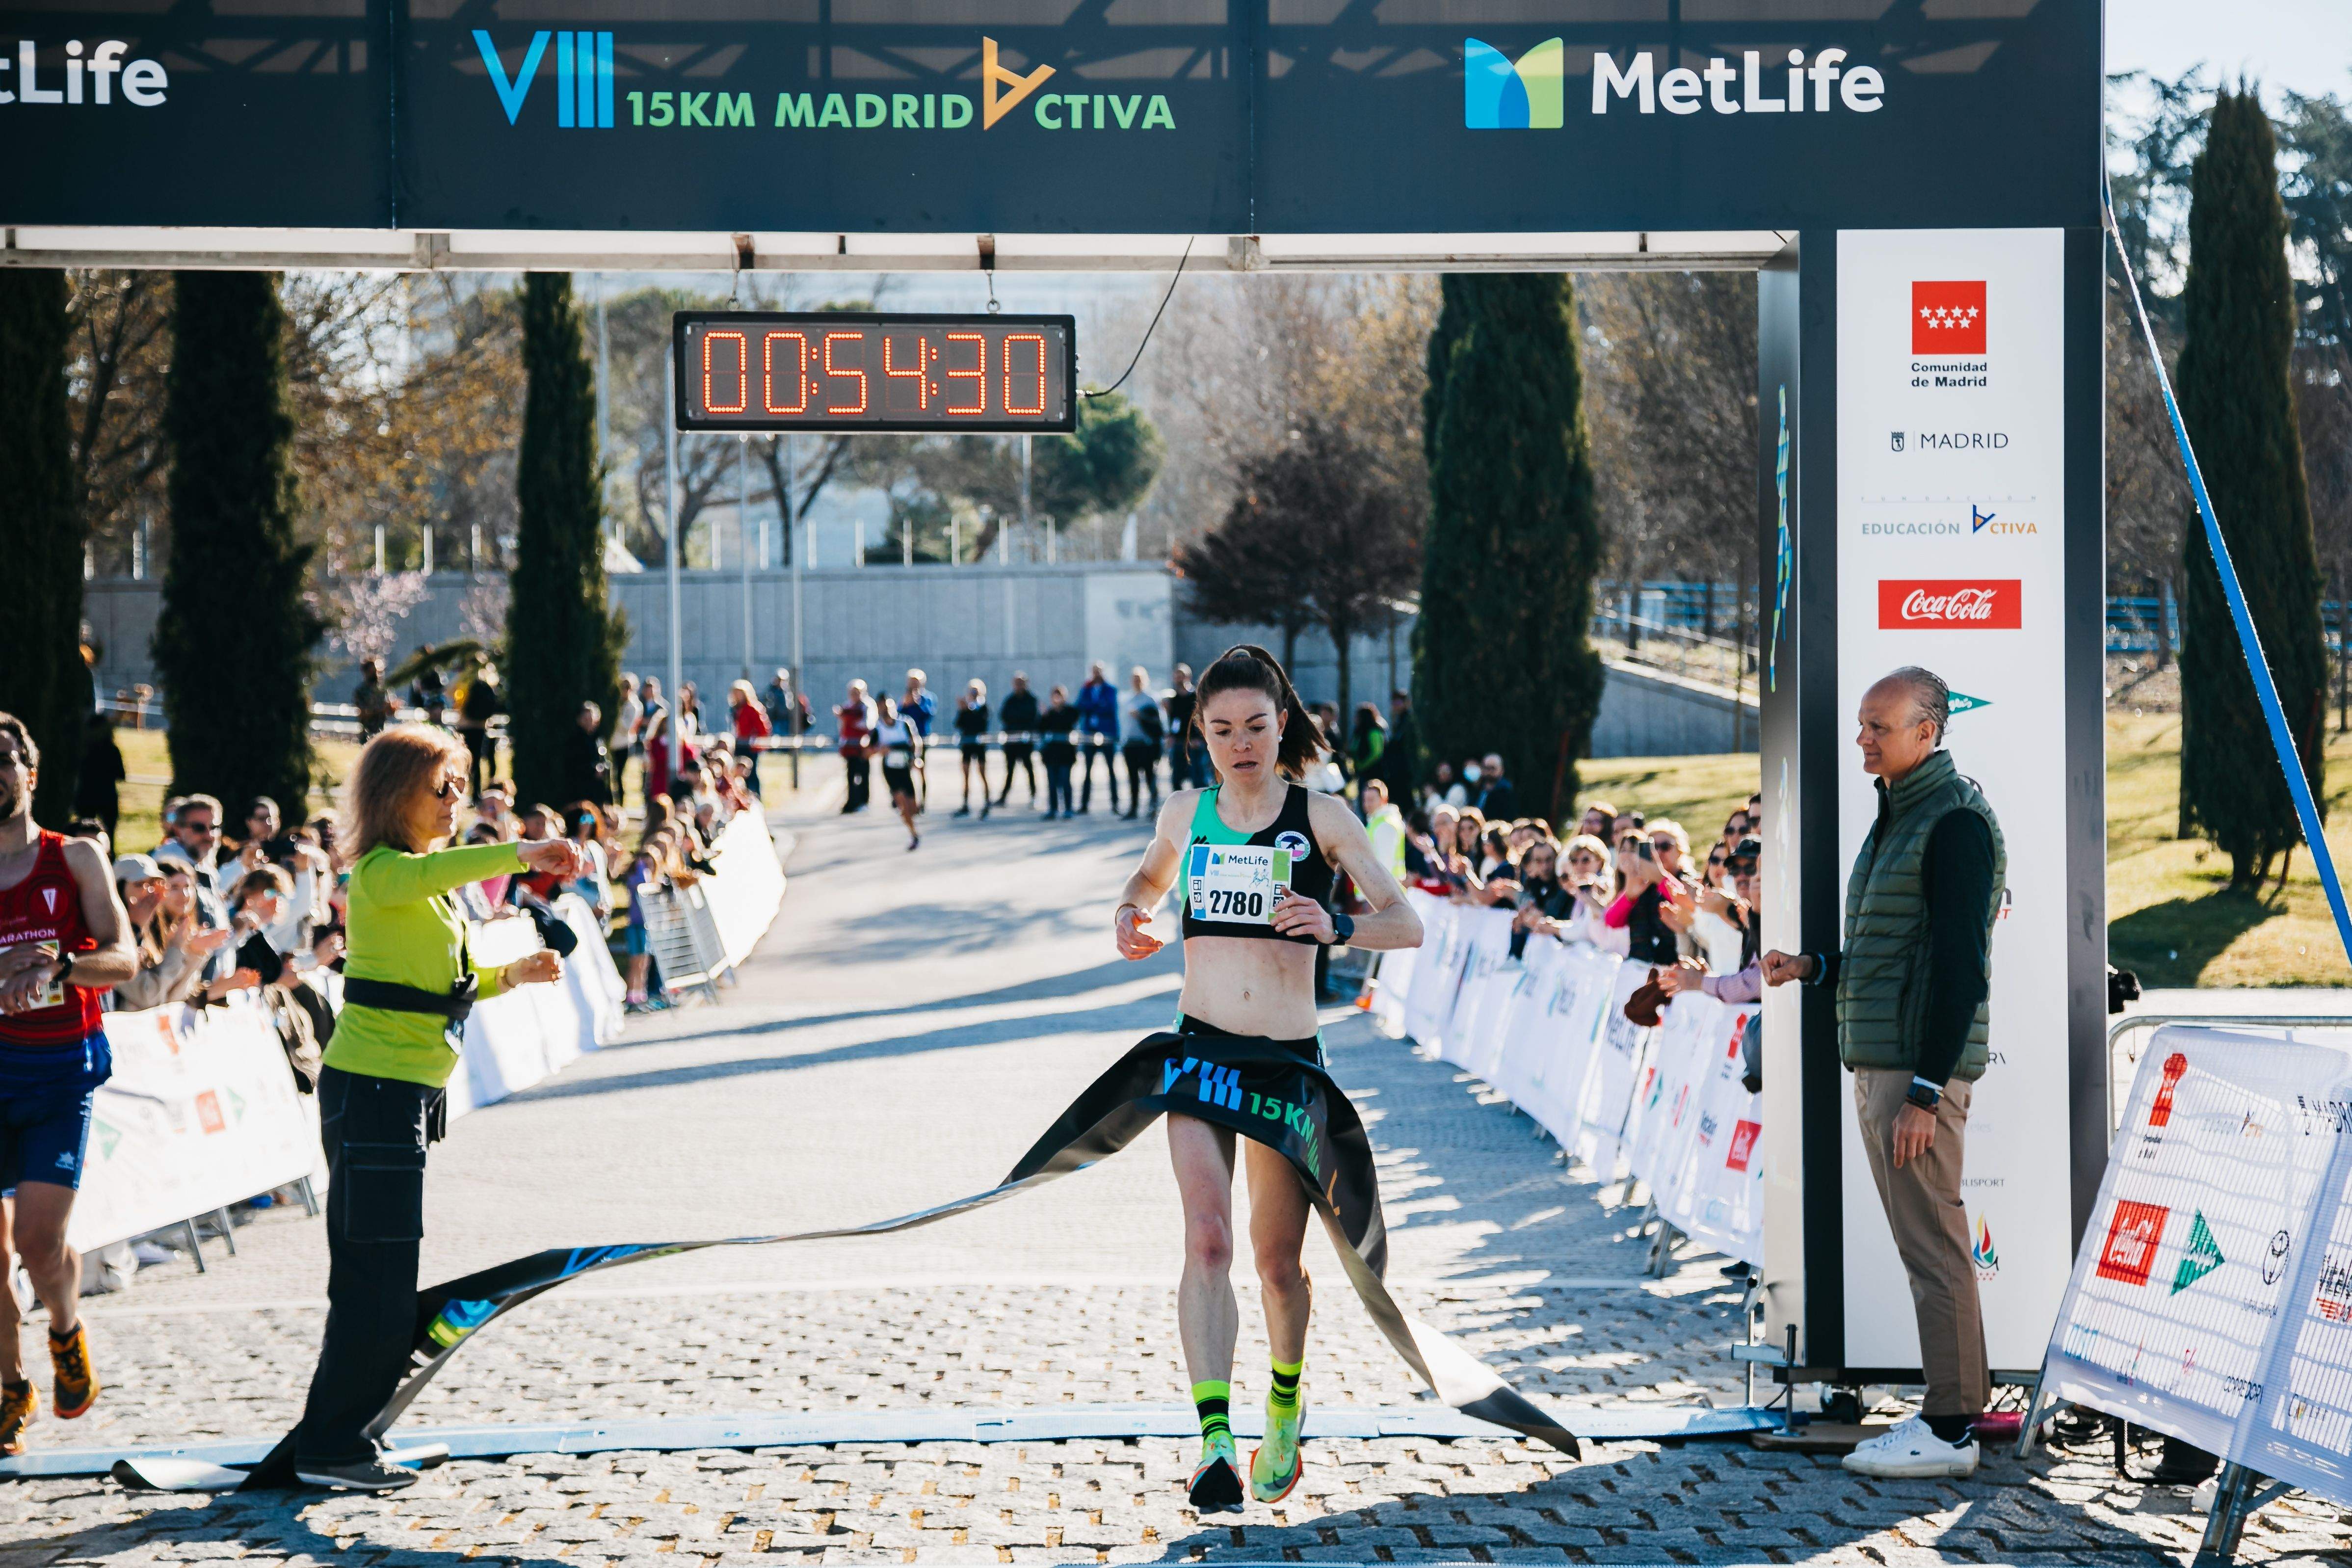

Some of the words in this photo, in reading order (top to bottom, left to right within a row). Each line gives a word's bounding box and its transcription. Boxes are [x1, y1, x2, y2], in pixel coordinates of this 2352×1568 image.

[472, 29, 614, 129] VIII
[626, 91, 756, 127] 15KM
[774, 92, 974, 129] MADRID
[1591, 48, 1885, 115] MetLife
[703, 331, 1045, 415] 00:54:30
[1911, 362, 1987, 372] Comunidad
[1911, 376, 1929, 387] de
[1935, 376, 1987, 387] Madrid
[1921, 433, 2008, 449] MADRID
[1862, 519, 1960, 534] EDUCACIÓN
[1228, 855, 1268, 866] MetLife
[1210, 890, 1263, 917] 2780
